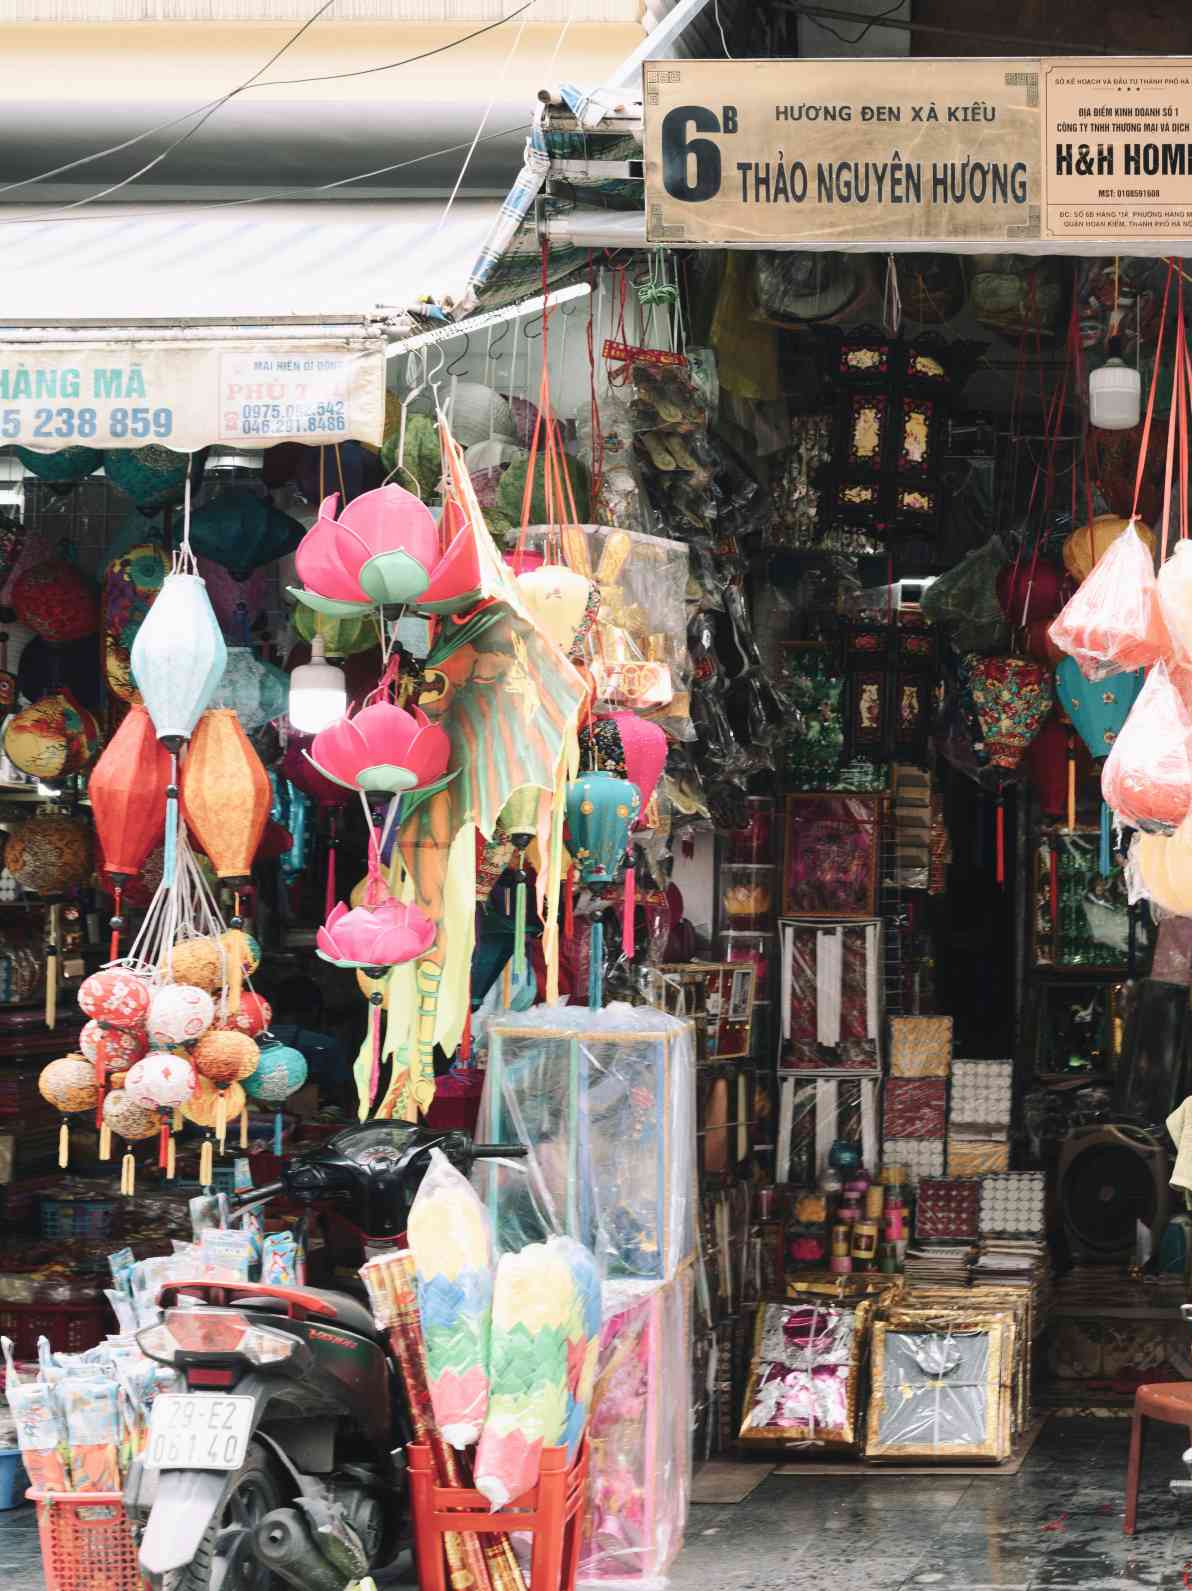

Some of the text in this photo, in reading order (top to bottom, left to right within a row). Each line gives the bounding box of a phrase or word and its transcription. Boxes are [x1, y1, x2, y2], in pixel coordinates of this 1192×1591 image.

[775, 103, 852, 121] HƯƠNG
[860, 105, 901, 122] ĐEN
[1056, 121, 1078, 133] CÔNG
[1079, 123, 1088, 133] TY
[1090, 123, 1110, 133] TNHH
[1114, 107, 1133, 117] KINH
[1134, 107, 1161, 117] DOANH
[1056, 143, 1114, 176] H&H
[736, 150, 1027, 204] THẢO NGUYÊN HƯƠNG
[93, 362, 145, 399] MÃ
[32, 408, 97, 438] 238
[109, 408, 173, 438] 859
